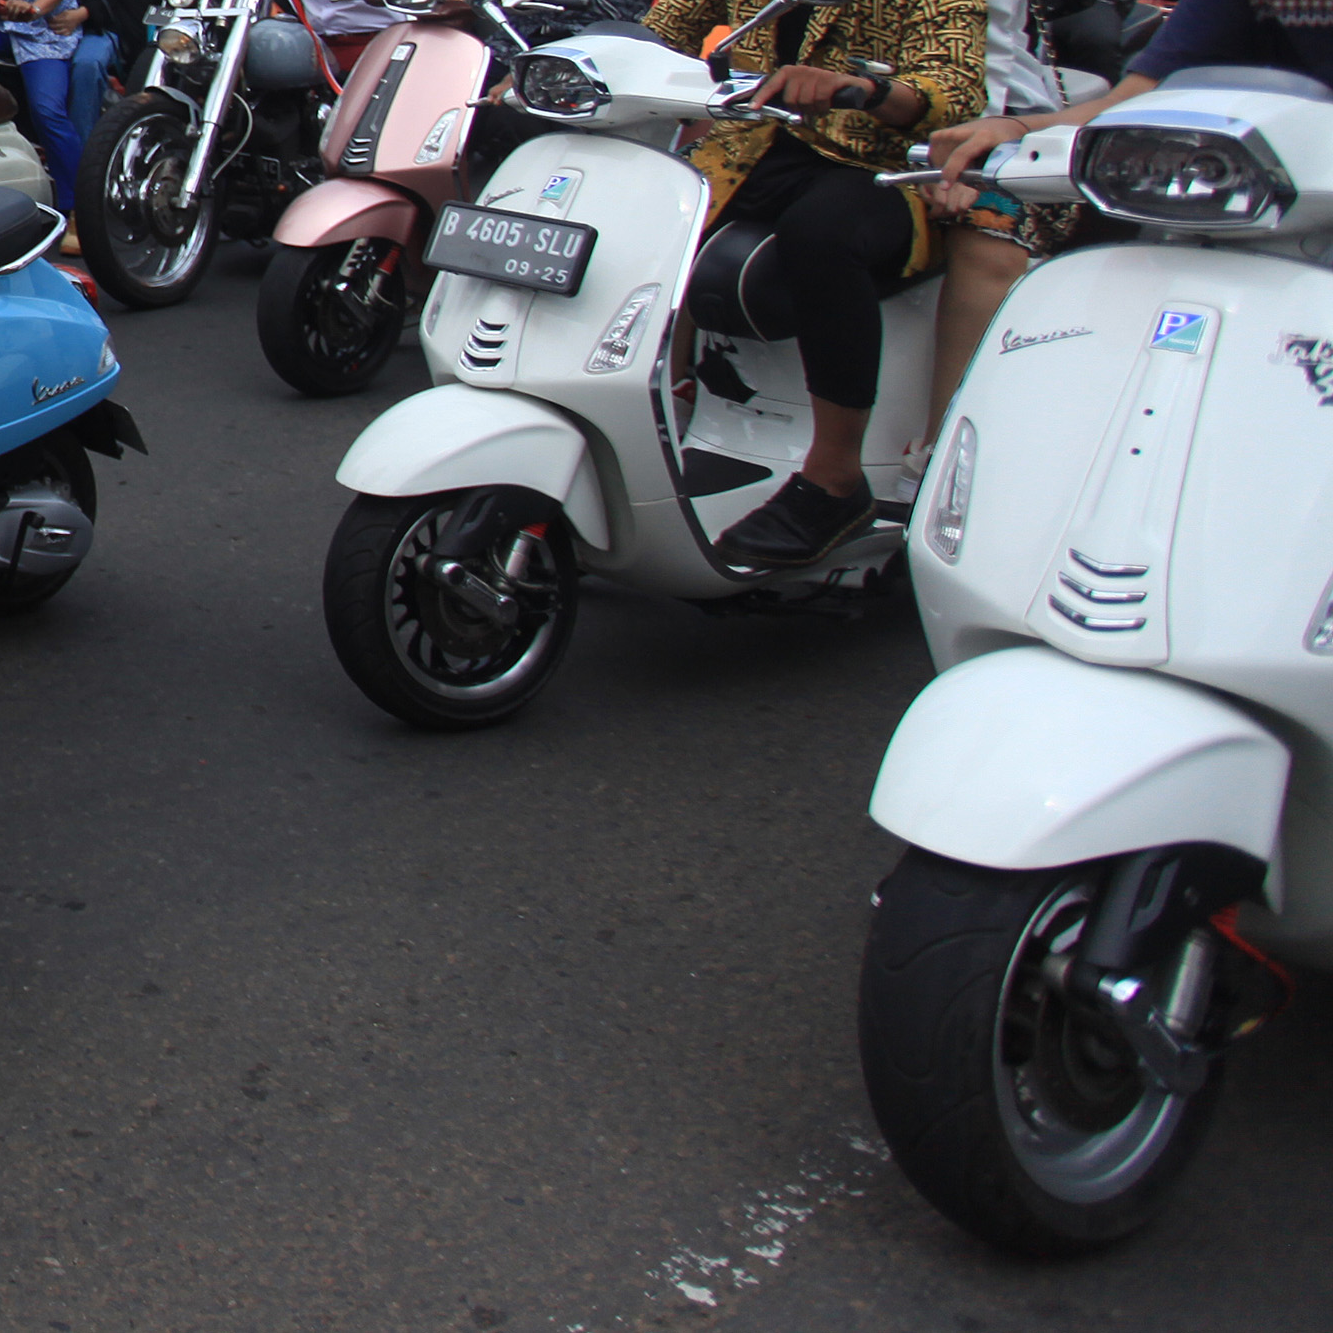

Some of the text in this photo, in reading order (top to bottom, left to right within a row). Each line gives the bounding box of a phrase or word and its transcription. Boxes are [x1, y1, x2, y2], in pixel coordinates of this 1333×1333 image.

[443, 212, 582, 258] B 4605 SLU
